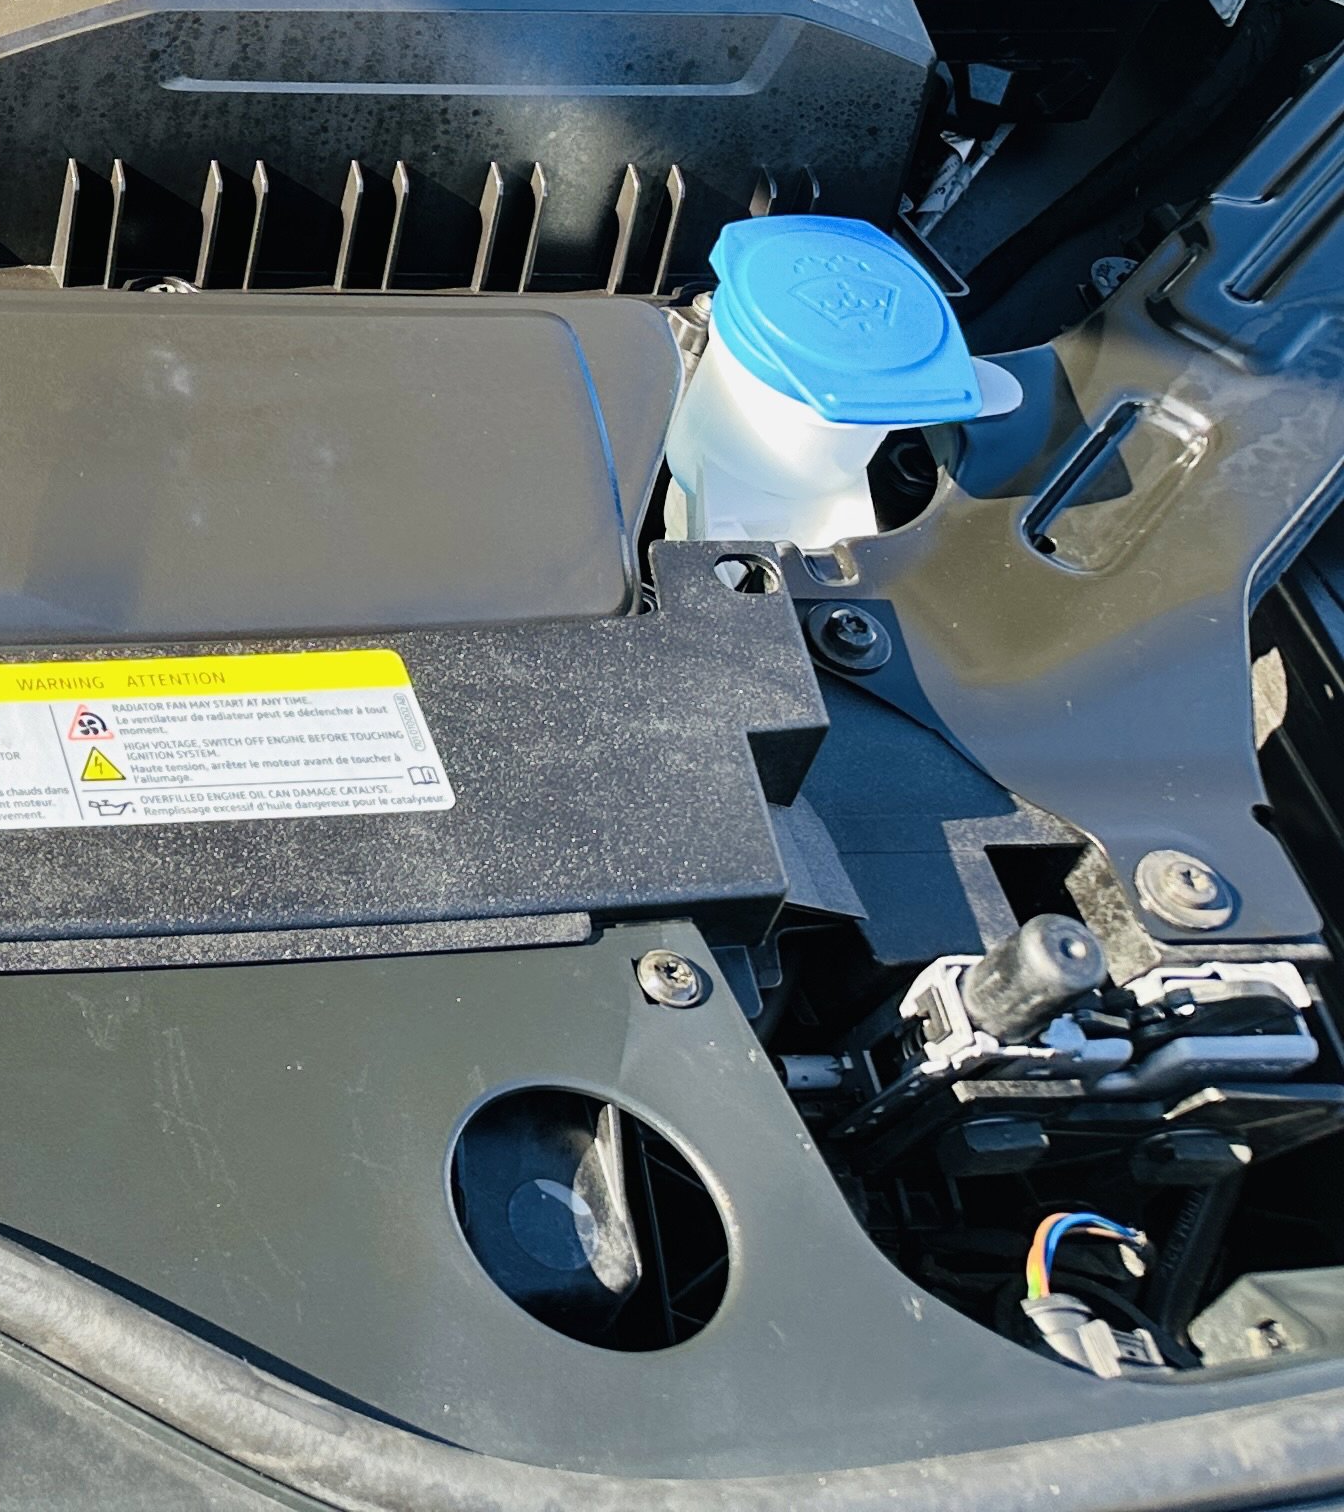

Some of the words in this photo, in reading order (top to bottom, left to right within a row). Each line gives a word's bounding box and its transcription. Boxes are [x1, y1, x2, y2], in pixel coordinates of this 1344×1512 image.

[16, 676, 104, 691] WARNING
[127, 672, 226, 687] ATTENTION
[112, 703, 163, 712] RADIATOR
[167, 701, 187, 710] FAN
[190, 700, 210, 709] MAY
[213, 699, 243, 708] START
[261, 697, 282, 706] ANY
[116, 716, 128, 725] Le
[132, 714, 188, 725] ventilateur
[191, 713, 204, 722] de
[207, 711, 254, 721] radiateur
[258, 710, 281, 721] peut
[298, 706, 354, 717] déclencher
[366, 705, 388, 714] tout
[119, 727, 167, 735] moment.
[124, 741, 150, 751] HIGH
[203, 738, 242, 748] SWITCH
[246, 737, 265, 745] OFF
[267, 735, 305, 745] ENGINE
[309, 733, 348, 743] BEFORE
[350, 730, 404, 741] TOUCHING
[127, 751, 174, 761] IGNITION
[130, 763, 162, 773] Haute
[166, 762, 209, 773] tension,
[211, 760, 247, 770] arrêter
[250, 760, 260, 768] le
[263, 759, 300, 768] moteur
[304, 757, 333, 766] avant
[336, 755, 349, 765] de
[352, 754, 391, 764] toucher
[6, 788, 42, 797] chauds
[45, 787, 69, 795] dans
[140, 794, 204, 805] OVERFILLED
[208, 792, 246, 801] ENGINE
[249, 790, 265, 798] OIL
[269, 789, 290, 798] CAN
[293, 787, 336, 797] DAMAGE
[144, 804, 210, 817] Remplissage
[213, 802, 254, 813] excessif
[295, 800, 350, 810] dangereux
[353, 799, 376, 808] pour
[378, 797, 388, 805] le
